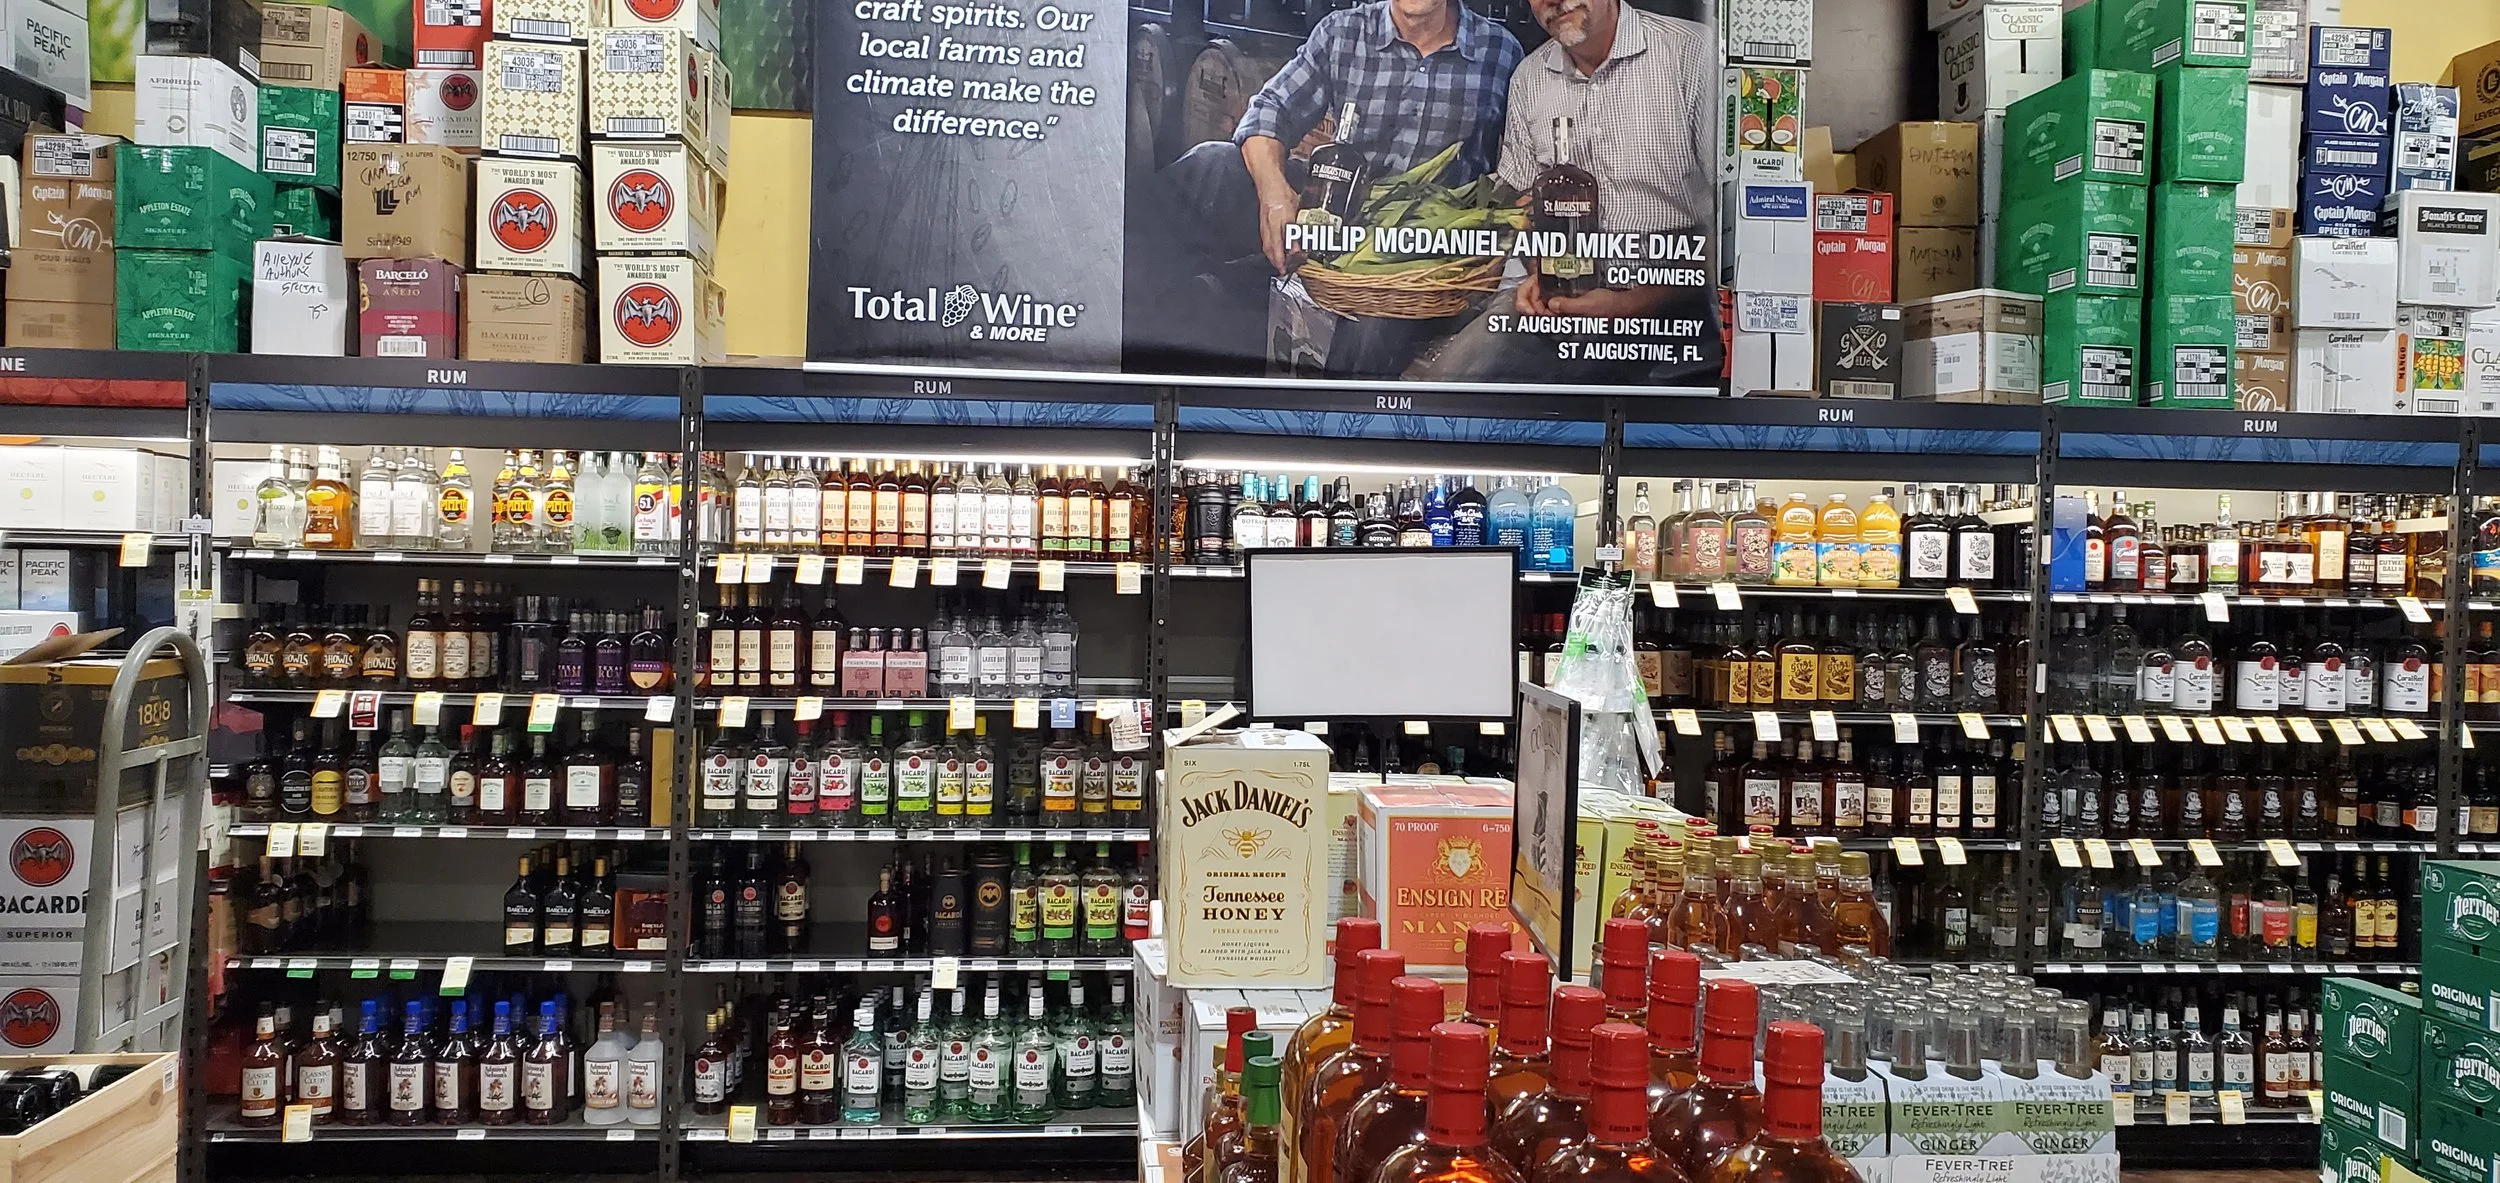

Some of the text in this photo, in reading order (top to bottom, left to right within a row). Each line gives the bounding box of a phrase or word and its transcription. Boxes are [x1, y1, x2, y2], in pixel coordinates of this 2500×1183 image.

[854, 0, 1094, 31] craft spirits. Our
[2002, 14, 2043, 24] CLASSIC
[27, 18, 71, 48] PACIFIC
[2008, 24, 2038, 34] CLUB
[34, 36, 66, 60] PEAK
[615, 39, 637, 50] 43036
[859, 32, 1085, 68] local farms and
[1944, 33, 1980, 65] CLASSIC
[512, 57, 535, 68] 43036
[1950, 56, 1975, 81] CLUB
[2319, 72, 2384, 88] Captain Morgan
[846, 70, 1096, 106] climate make the
[346, 151, 376, 161] 12/750
[618, 150, 672, 158] WORLD'S MOST
[1753, 156, 1784, 166] BACARDÍ
[502, 169, 558, 179] WORLD'S MOST
[1324, 165, 1353, 181] AUGUSTINE
[532, 178, 544, 186] RUM
[32, 182, 113, 200] Captain Morgan
[1554, 200, 1590, 212] AUGUSTINE
[1749, 195, 1803, 205] Admiral Nelson's
[139, 202, 192, 216] APPLETON ESTATE
[2314, 206, 2376, 222] Captain Morgan
[2421, 209, 2484, 223] Jonah's Curse
[2319, 227, 2370, 236] SPICED RUM
[1285, 223, 1706, 262] PHILIP MCDANIEL AND MIKE DIAZ
[1817, 238, 1886, 255] Captain Morgan
[2332, 241, 2366, 250] CoralReef
[2255, 252, 2286, 266] Morgan
[375, 268, 429, 280] BARCELÓ
[625, 264, 658, 272] WORLD'S
[655, 272, 667, 280] RUM
[1607, 267, 1705, 286] CO-OWNERS
[383, 287, 421, 296] AÑEJO
[847, 287, 1077, 328] Total Wine
[1753, 298, 1774, 306] 43028
[142, 307, 196, 321] APPLETON ESTATE
[2426, 310, 2446, 321] 43100
[1488, 315, 1703, 337] ST. AUGUSTINE DISTILLERY
[969, 326, 1048, 342] & MORE
[2328, 334, 2364, 343] CoralReef
[1558, 342, 1703, 364] ST AUGUSTINE, FL
[1, 357, 25, 371] NE
[2253, 353, 2285, 371] Morgan
[427, 369, 467, 385] RUM
[913, 380, 951, 394] RUM
[1376, 395, 1412, 410] RUM
[1818, 408, 1854, 421] RUM
[2243, 420, 2278, 432] RUM
[639, 496, 652, 509] 51
[25, 561, 65, 569] PACIFIC
[2319, 674, 2344, 682] CoralReef
[2397, 674, 2425, 682] CoralReef
[707, 767, 734, 775] BACARDÍ
[750, 767, 775, 775] BACARDÍ
[822, 767, 848, 775] BACARDÍ
[1114, 768, 1139, 777] BACARDÍ
[1180, 780, 1313, 828] JACK DANIEL'S
[1394, 822, 1510, 833] 70 PROOF 6-750
[1047, 896, 1071, 905] BACARDÍ
[1090, 896, 1116, 905] BACARDÍ
[1203, 885, 1285, 903] Tennessee
[1396, 887, 1508, 910] ENSIGN RE
[1202, 908, 1285, 921] HONEY
[2453, 894, 2500, 932] perrier
[2431, 983, 2485, 1011] ORIGINAL
[2348, 1012, 2388, 1045] perrier
[944, 1053, 968, 1062] BACARDÍ
[1070, 1048, 1094, 1057] BACARDÍ
[1105, 1047, 1130, 1055] BACARDÍ
[769, 1067, 793, 1075] BACARDÍ
[804, 1062, 830, 1070] BACARDÍ
[907, 1061, 930, 1069] BACARDÍ
[971, 1061, 995, 1069] BACARDÍ
[1019, 1061, 1044, 1070] BACARDÍ
[1903, 1104, 1993, 1117] FEVER-TREE
[2015, 1102, 2104, 1115] FEVER-TREE
[2330, 1090, 2375, 1120] ORIGINAL
[1911, 1118, 1986, 1132] Refreshingly Light
[2023, 1116, 2097, 1131] Refreshingly Light
[1920, 1139, 1978, 1151] GINGER
[2033, 1138, 2091, 1150] GINGER
[2431, 1138, 2488, 1173] ORIGINAL
[1926, 1159, 2014, 1172] FEVER-TREE
